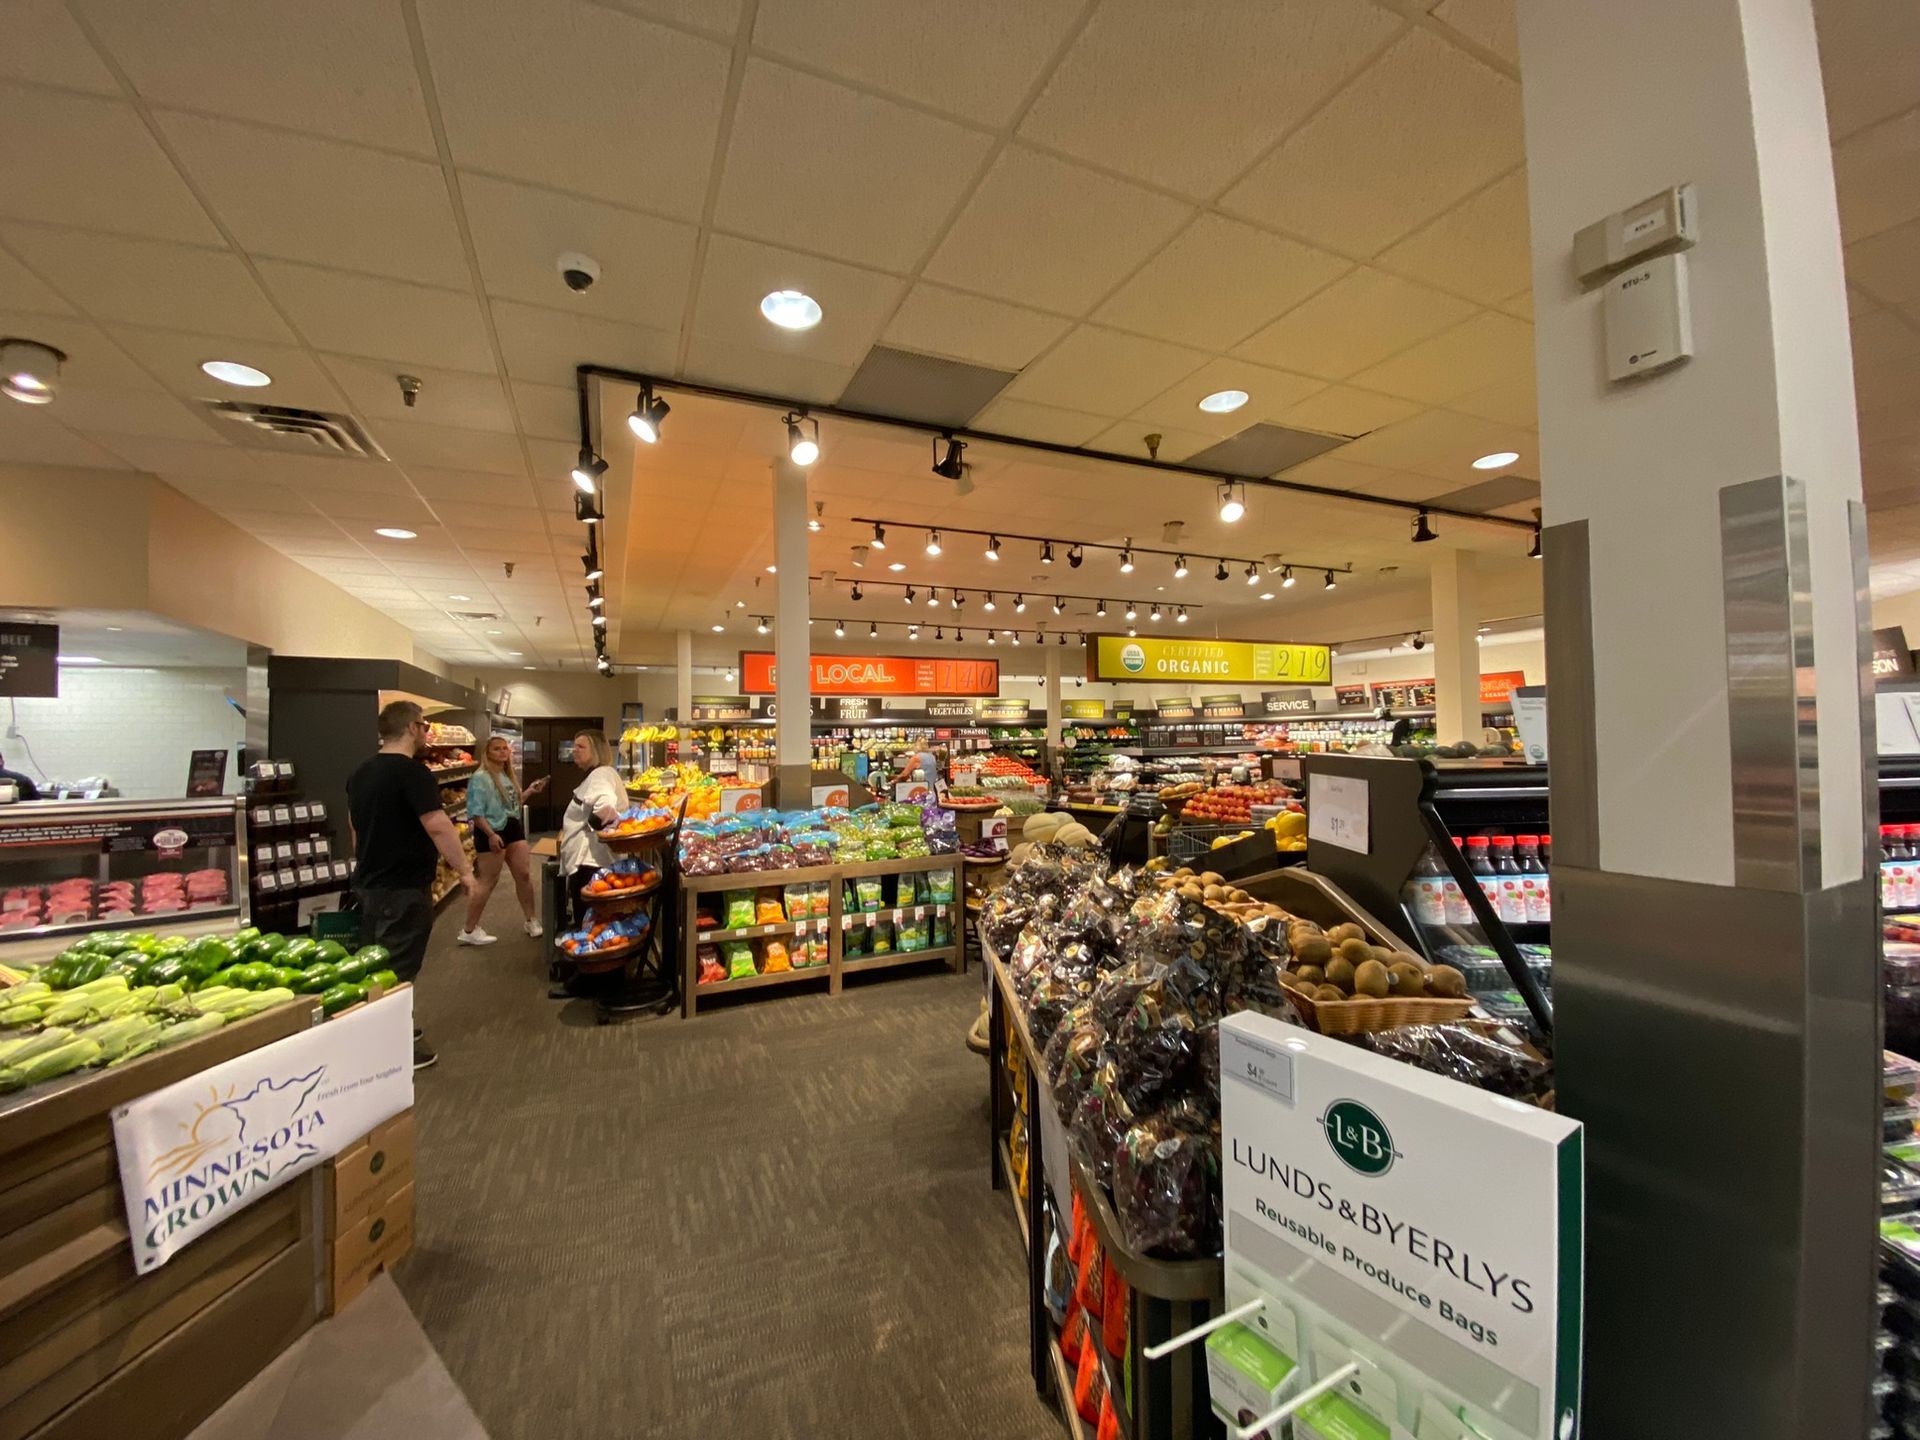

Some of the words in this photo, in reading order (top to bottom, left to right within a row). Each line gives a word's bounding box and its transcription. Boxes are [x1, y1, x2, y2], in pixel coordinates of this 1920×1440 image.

[1161, 645, 1225, 659] CERTIFIED
[1156, 659, 1230, 674] ORGANIC
[1277, 650, 1327, 678] 219
[816, 663, 896, 684] LOCAL.
[839, 698, 868, 706] FRESH
[928, 706, 974, 716] VEGETABLES
[1266, 699, 1310, 712] SERVICE
[839, 708, 868, 719] FRUIT
[1333, 1112, 1384, 1160] L&B
[144, 1110, 325, 1222] MINNESOTA
[145, 1159, 271, 1248] GROWN
[1255, 1197, 1337, 1255] Reusable
[1342, 1246, 1432, 1310] Produce
[1438, 1299, 1498, 1346] Bags
